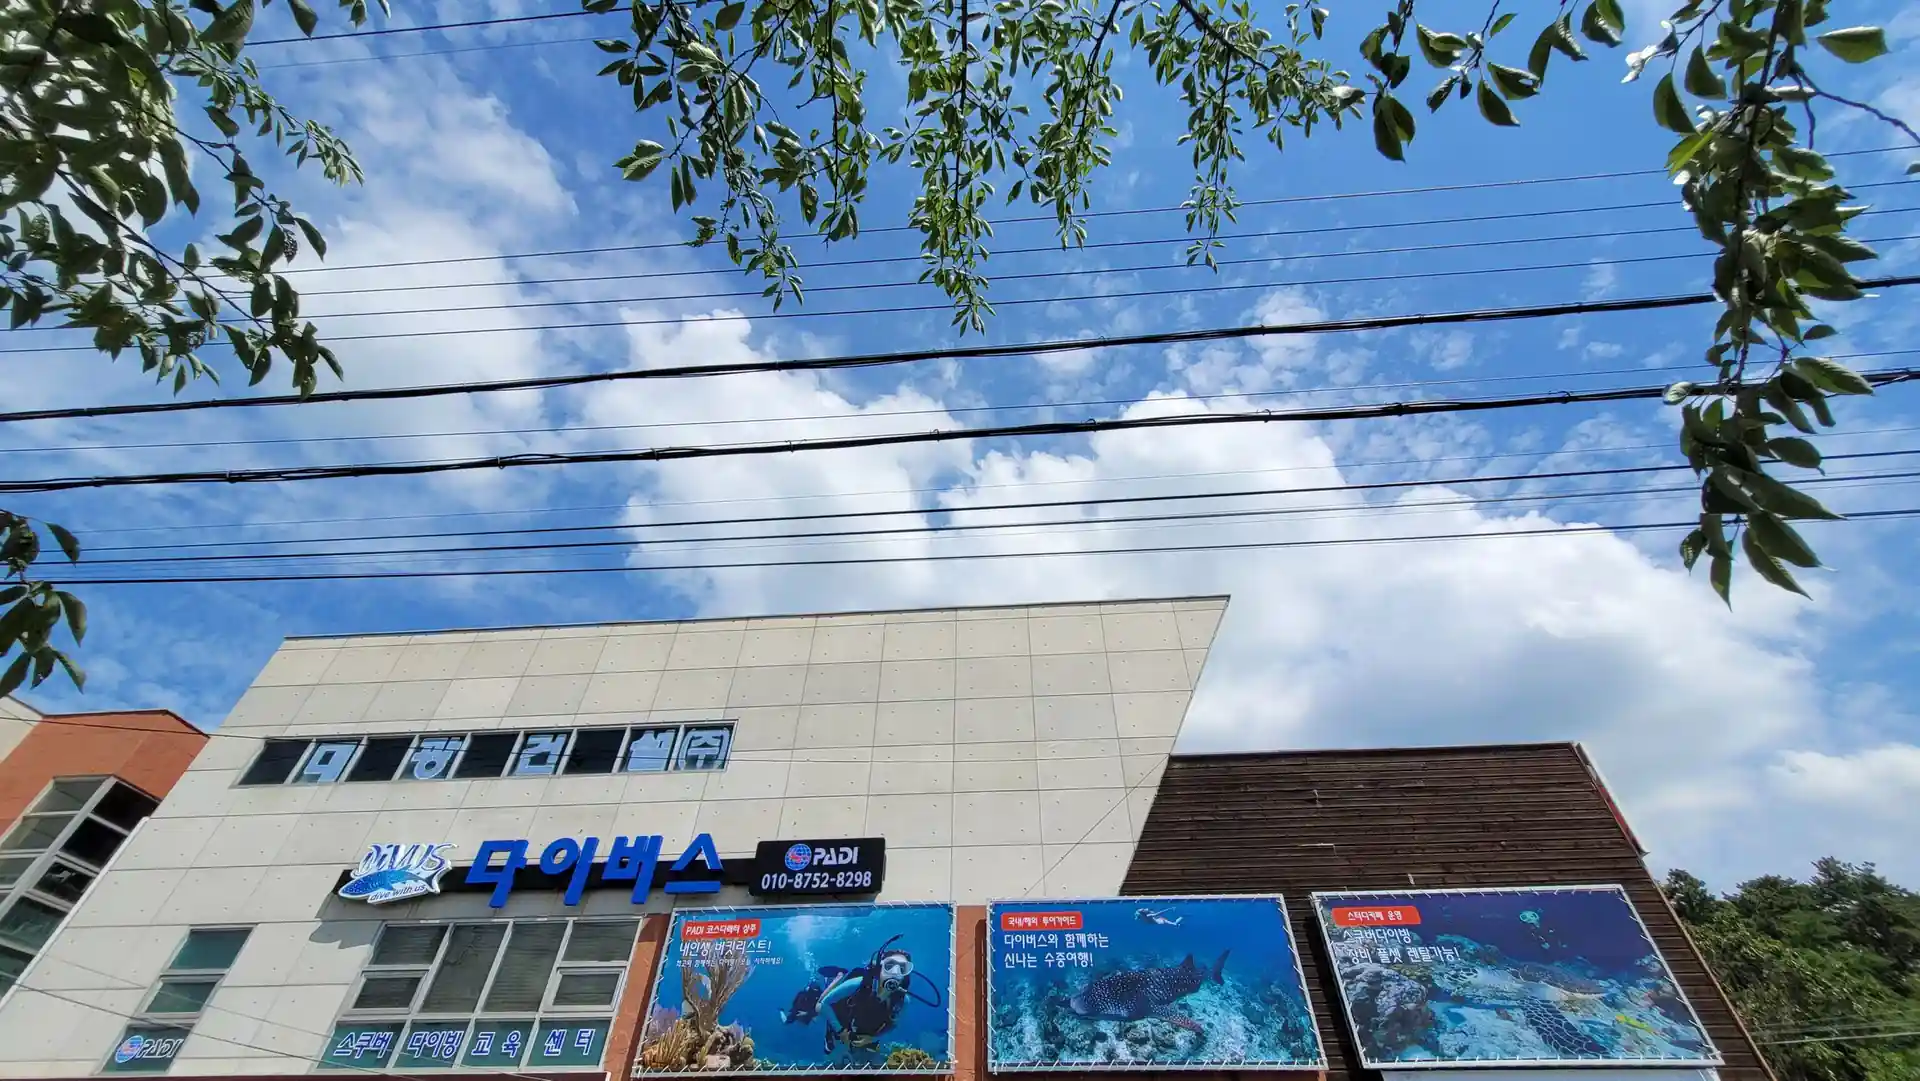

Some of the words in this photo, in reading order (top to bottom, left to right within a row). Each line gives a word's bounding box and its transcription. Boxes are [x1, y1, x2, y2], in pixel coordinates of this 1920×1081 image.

[812, 847, 859, 866] PADI
[464, 833, 724, 908] 다이버스
[761, 871, 872, 889] 010-8752-8298
[370, 890, 390, 901] dive
[392, 886, 413, 898] with
[414, 884, 426, 893] us
[686, 925, 705, 936] PADI
[1343, 928, 1412, 944] 스쿠버다이빙
[715, 940, 772, 956] 버킷리스트!
[1004, 934, 1059, 949] 다이버스와
[1065, 933, 1109, 948] 함께하는
[1004, 953, 1038, 968] 신나는
[1044, 952, 1094, 968] 수중여행!
[1348, 947, 1373, 964] 장비
[1405, 946, 1461, 963] 렌탈가능!
[134, 1038, 184, 1058] PADI
[333, 1031, 394, 1059] 스쿠버
[407, 1030, 465, 1058] 다이빙
